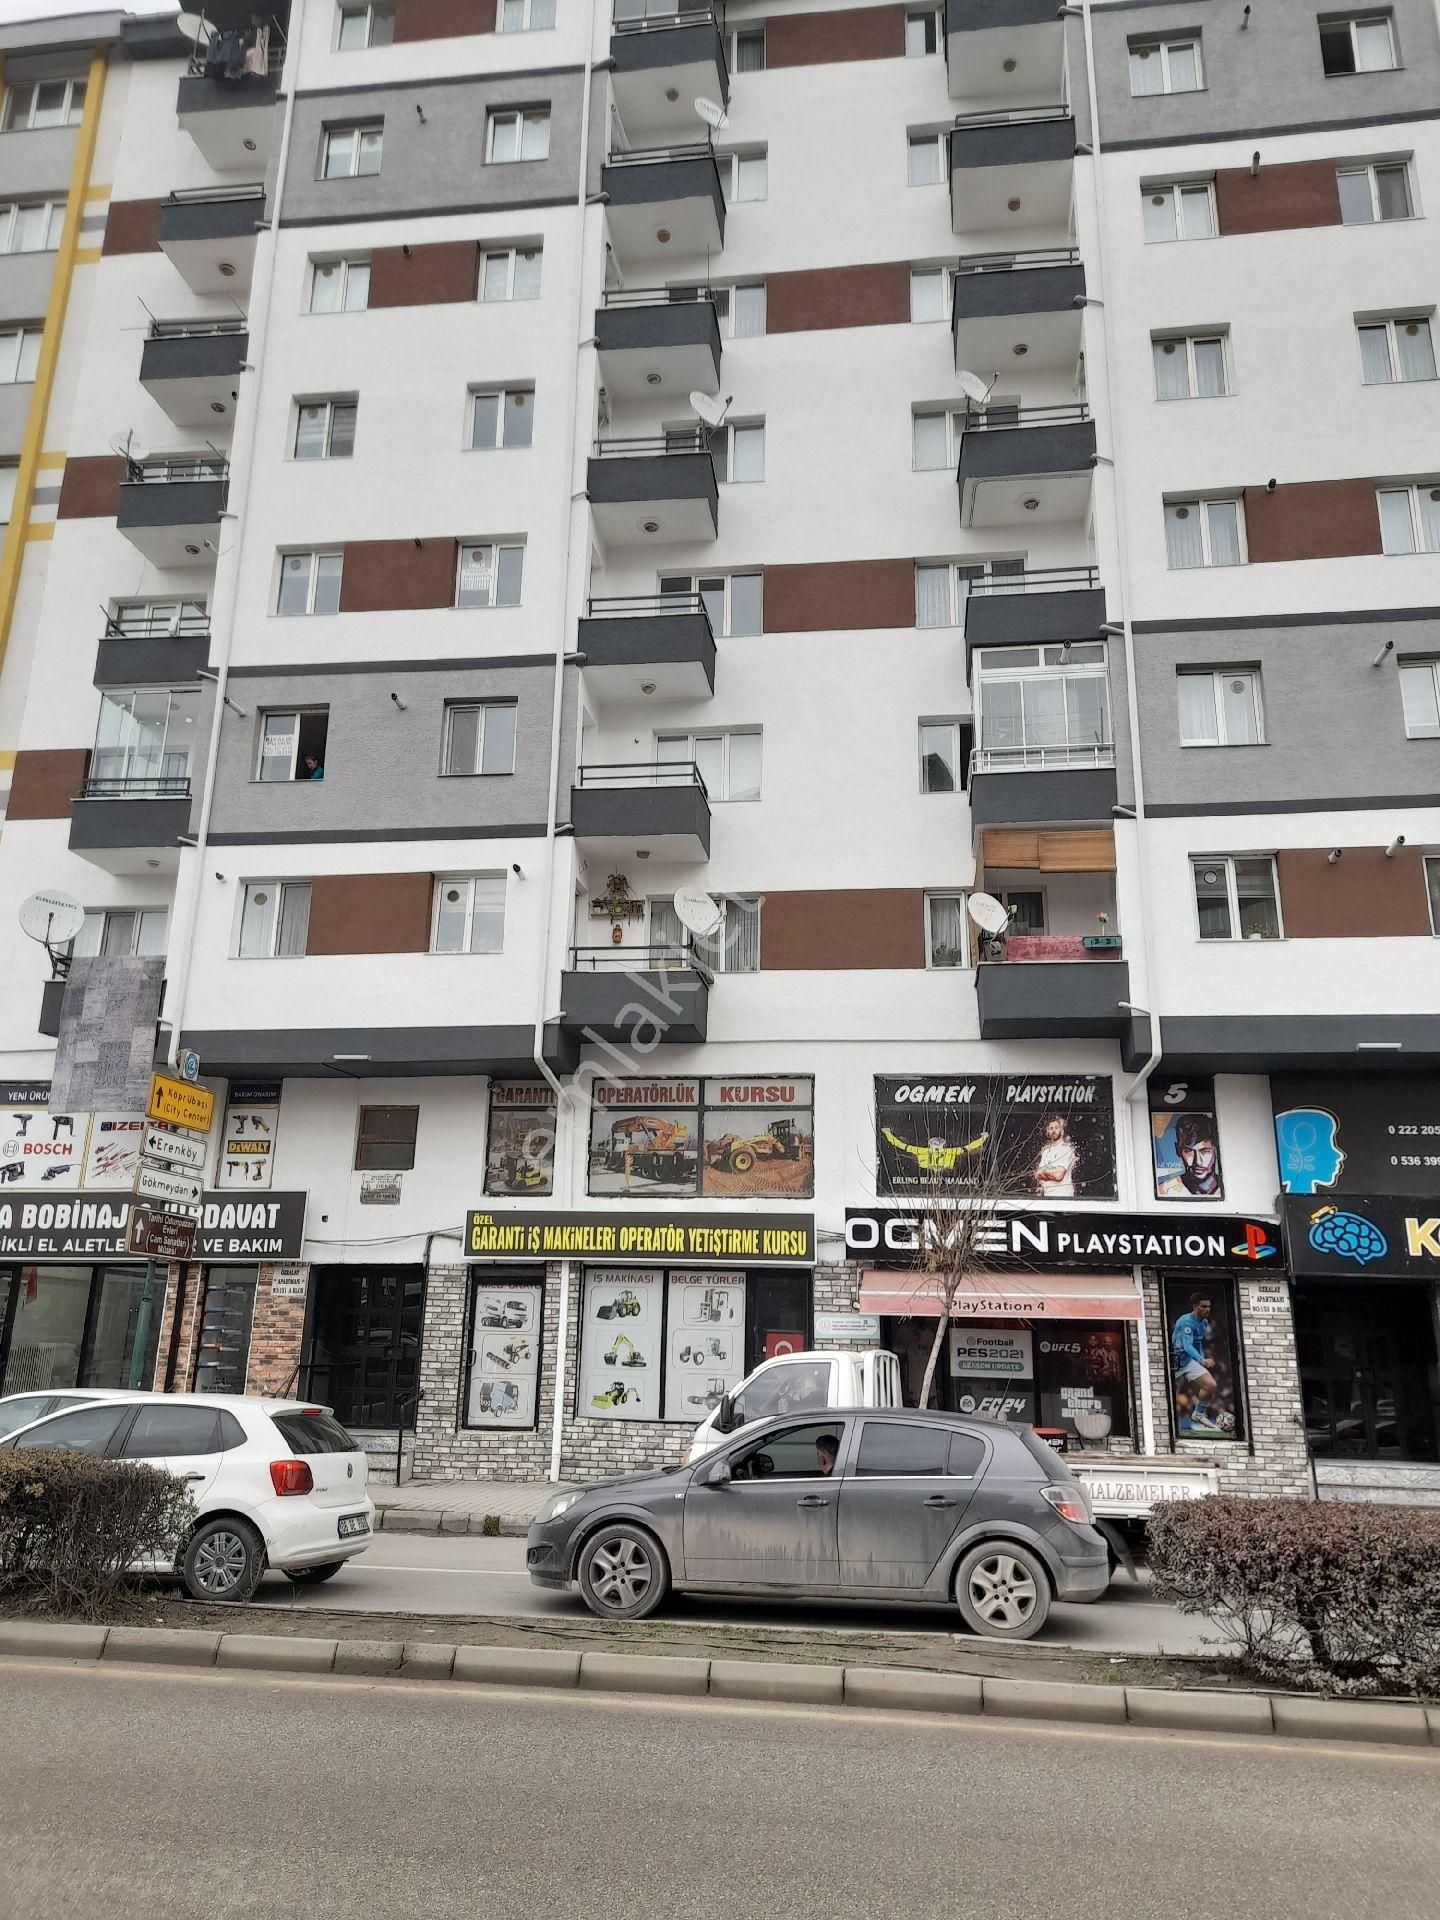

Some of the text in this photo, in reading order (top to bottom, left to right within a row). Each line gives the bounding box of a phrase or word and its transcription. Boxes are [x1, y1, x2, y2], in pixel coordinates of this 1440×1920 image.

[8, 1091, 27, 1101] YENİ
[597, 1083, 695, 1103] OPERATÖRLÜK
[720, 1086, 795, 1103] KURSU
[894, 1085, 976, 1103] OGMEN
[1163, 1083, 1188, 1104] 5
[163, 1104, 210, 1124] (City Center)
[1388, 1125, 1440, 1135] 0 222 205
[23, 1143, 73, 1155] BOSCH
[156, 1138, 198, 1162] Erenköy
[1390, 1156, 1398, 1166] 0
[1400, 1156, 1421, 1166] 536
[142, 1175, 189, 1196] Gökmeydan
[892, 1176, 919, 1185] ERLING
[21, 1199, 130, 1229] BOBİNAJ
[473, 1212, 495, 1225] ÖZEL
[619, 1224, 685, 1252] OPERATÖR
[763, 1229, 808, 1256] KURSU
[845, 1216, 1226, 1257] OGMEN PLAYSTATION
[37, 1238, 60, 1252] EL
[203, 1238, 224, 1252] VE
[229, 1238, 283, 1253] BAKIM
[605, 1272, 655, 1285] MAKİNASI
[671, 1275, 703, 1284] BELGE
[950, 1300, 1046, 1314] PlayStation 4
[1060, 1386, 1094, 1399] grand
[1084, 1482, 1190, 1501] MALZEMELER
